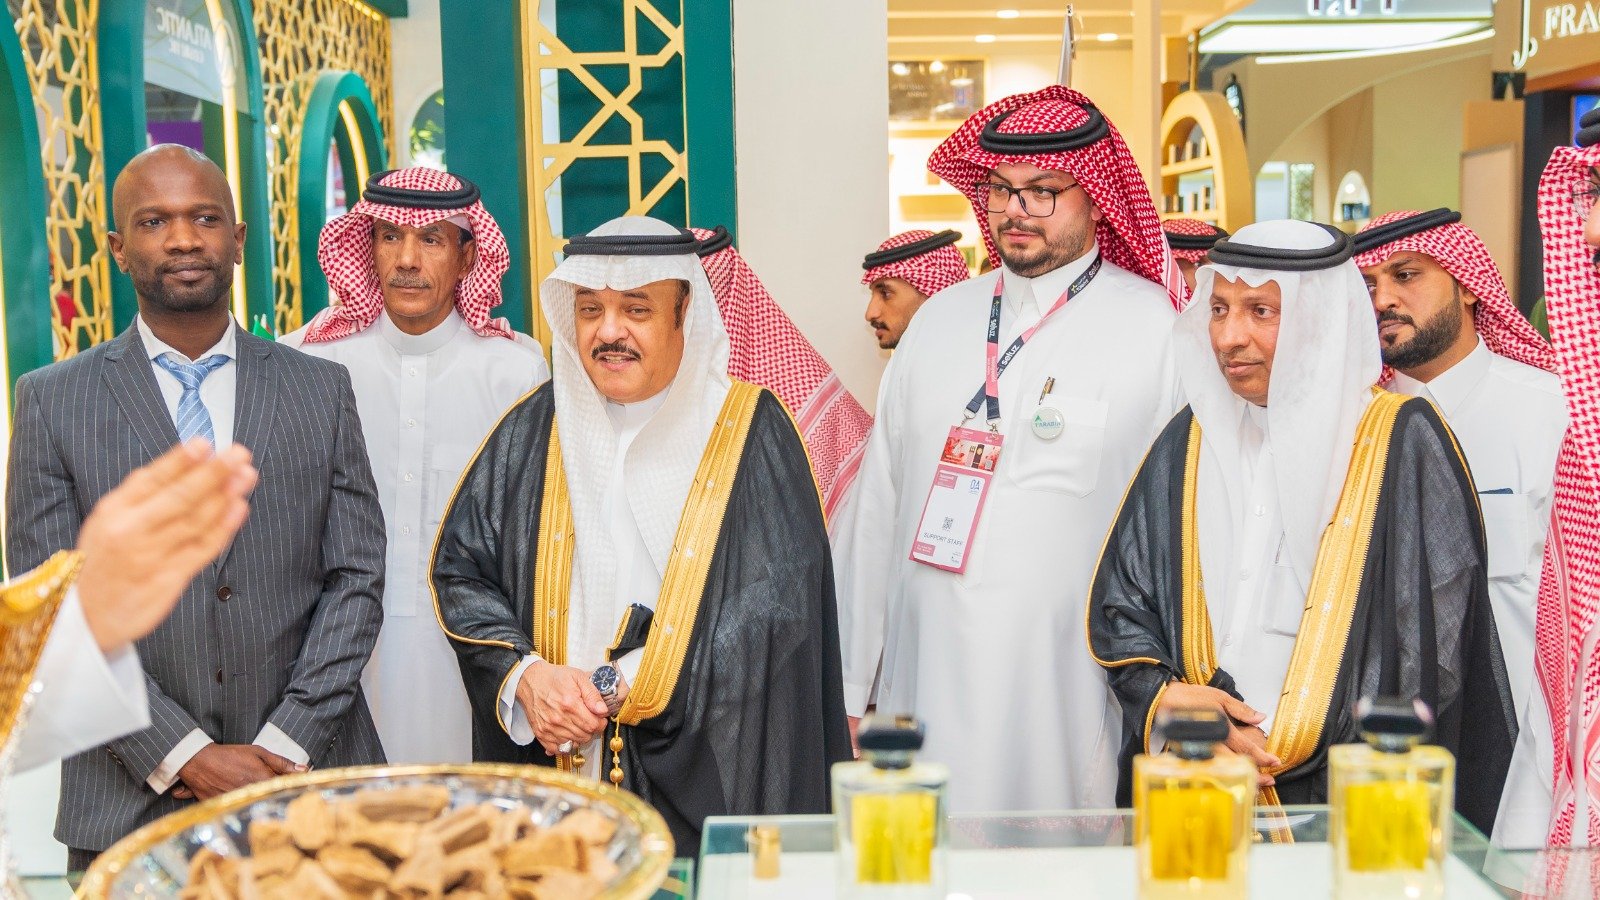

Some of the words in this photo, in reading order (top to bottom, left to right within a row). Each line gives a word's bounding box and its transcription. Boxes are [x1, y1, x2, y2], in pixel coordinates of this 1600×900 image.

[1543, 0, 1600, 40] FRA
[923, 532, 947, 542] SUPPORT
[946, 538, 962, 546] STAFF
